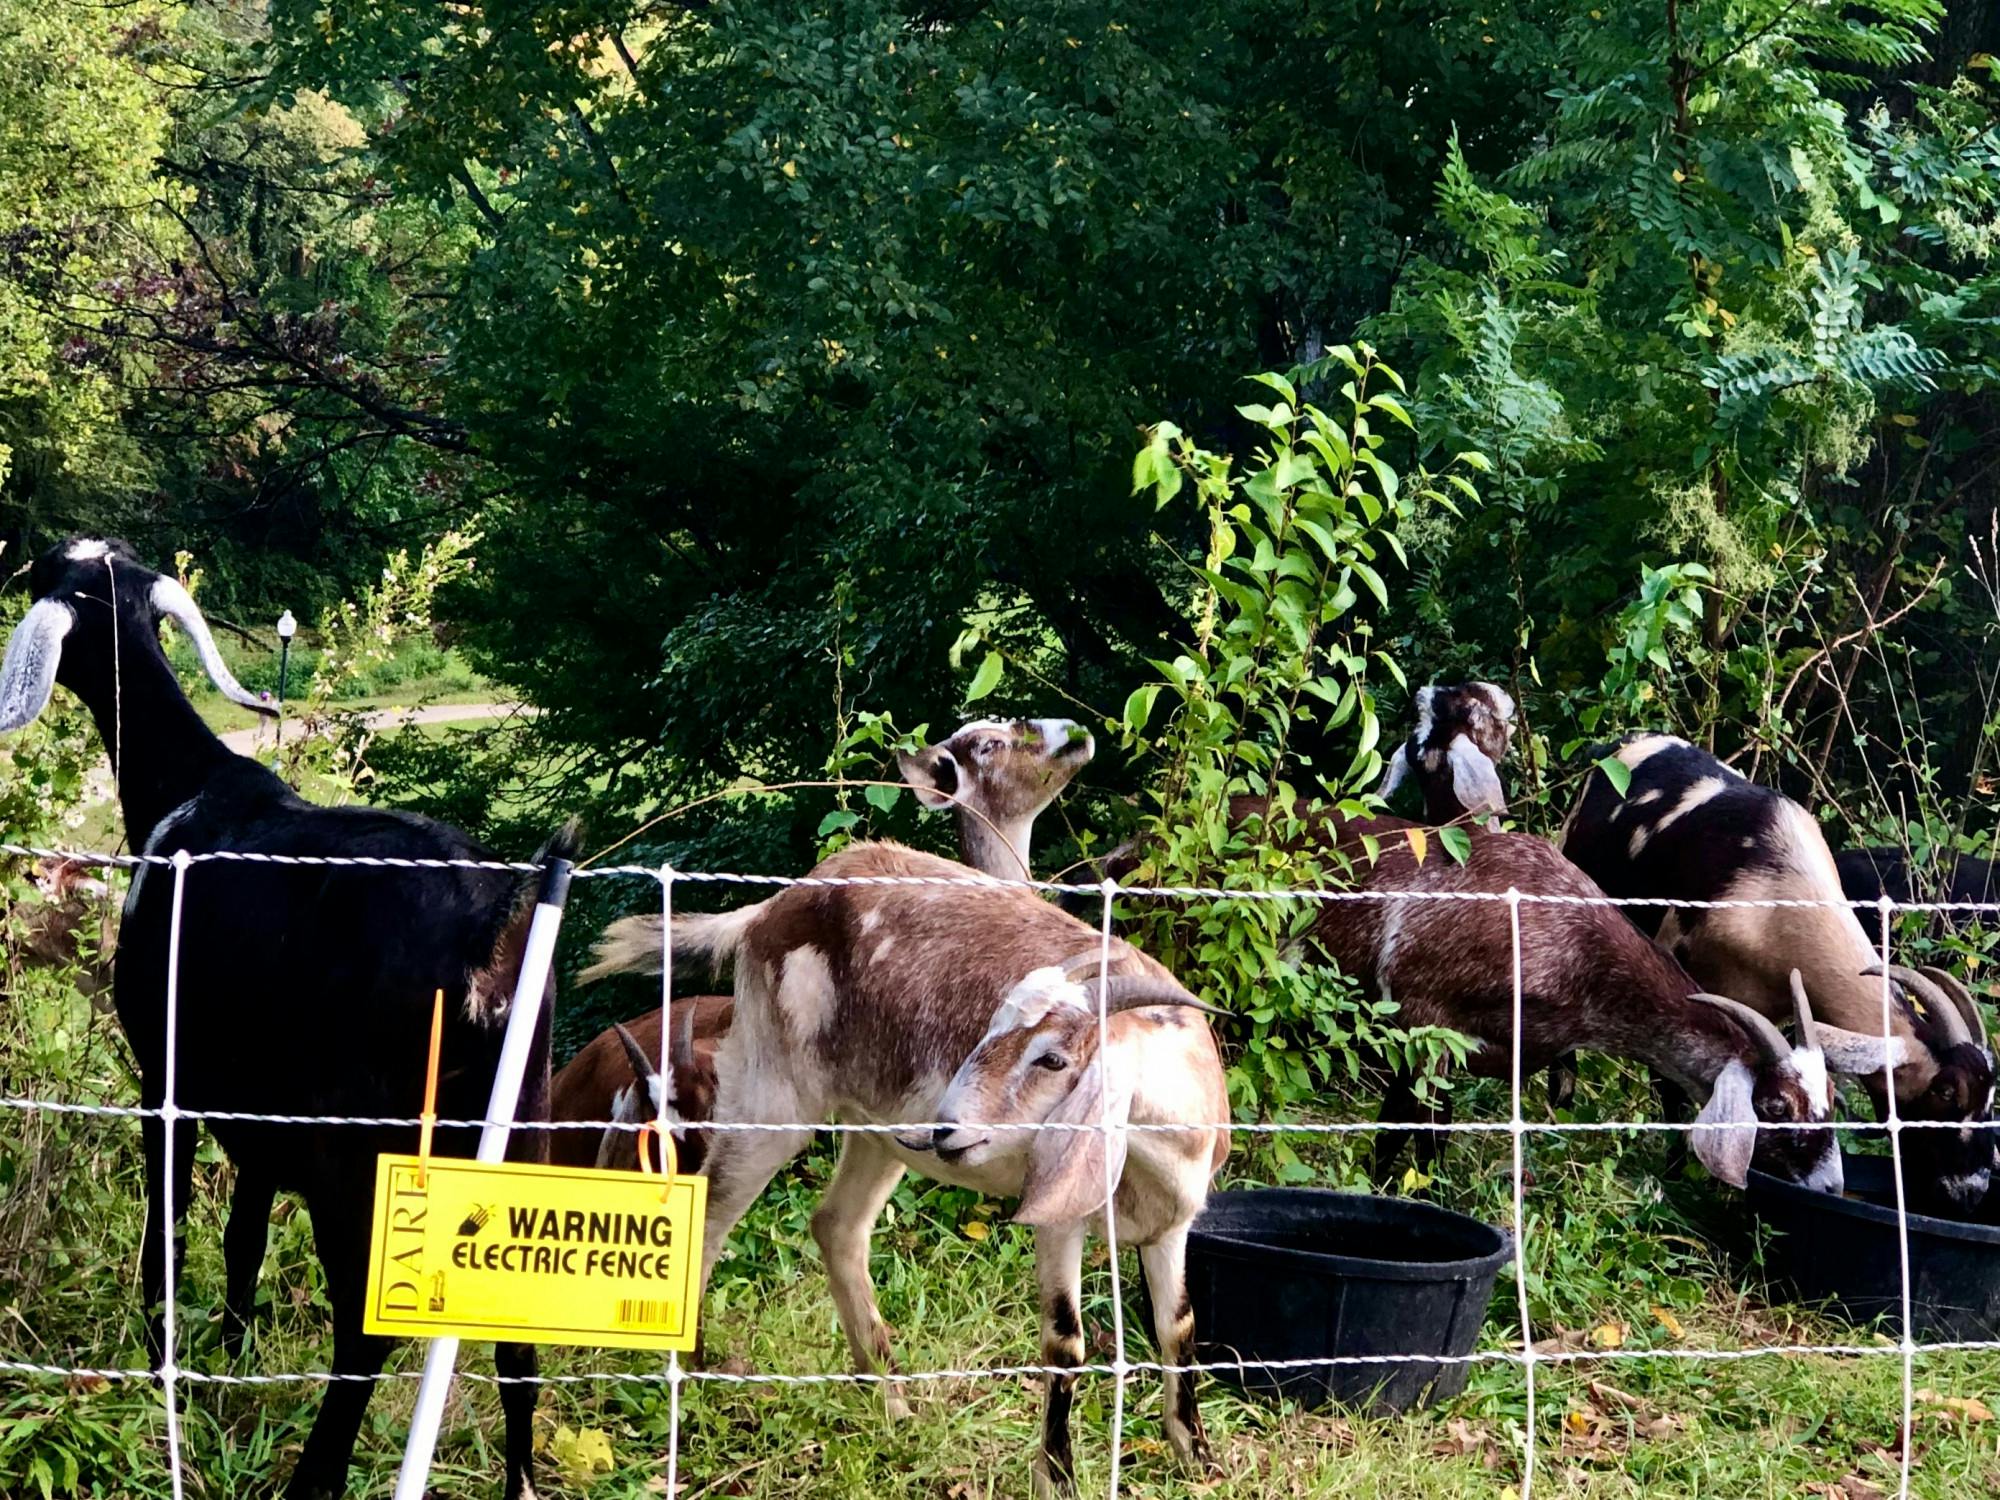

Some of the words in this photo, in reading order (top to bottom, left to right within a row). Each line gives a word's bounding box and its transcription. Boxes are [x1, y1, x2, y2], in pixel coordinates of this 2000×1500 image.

[385, 1172, 430, 1313] DARE
[508, 1206, 673, 1248] WARNING
[451, 1241, 578, 1275] ELECTRIC
[585, 1250, 670, 1280] FENCE
